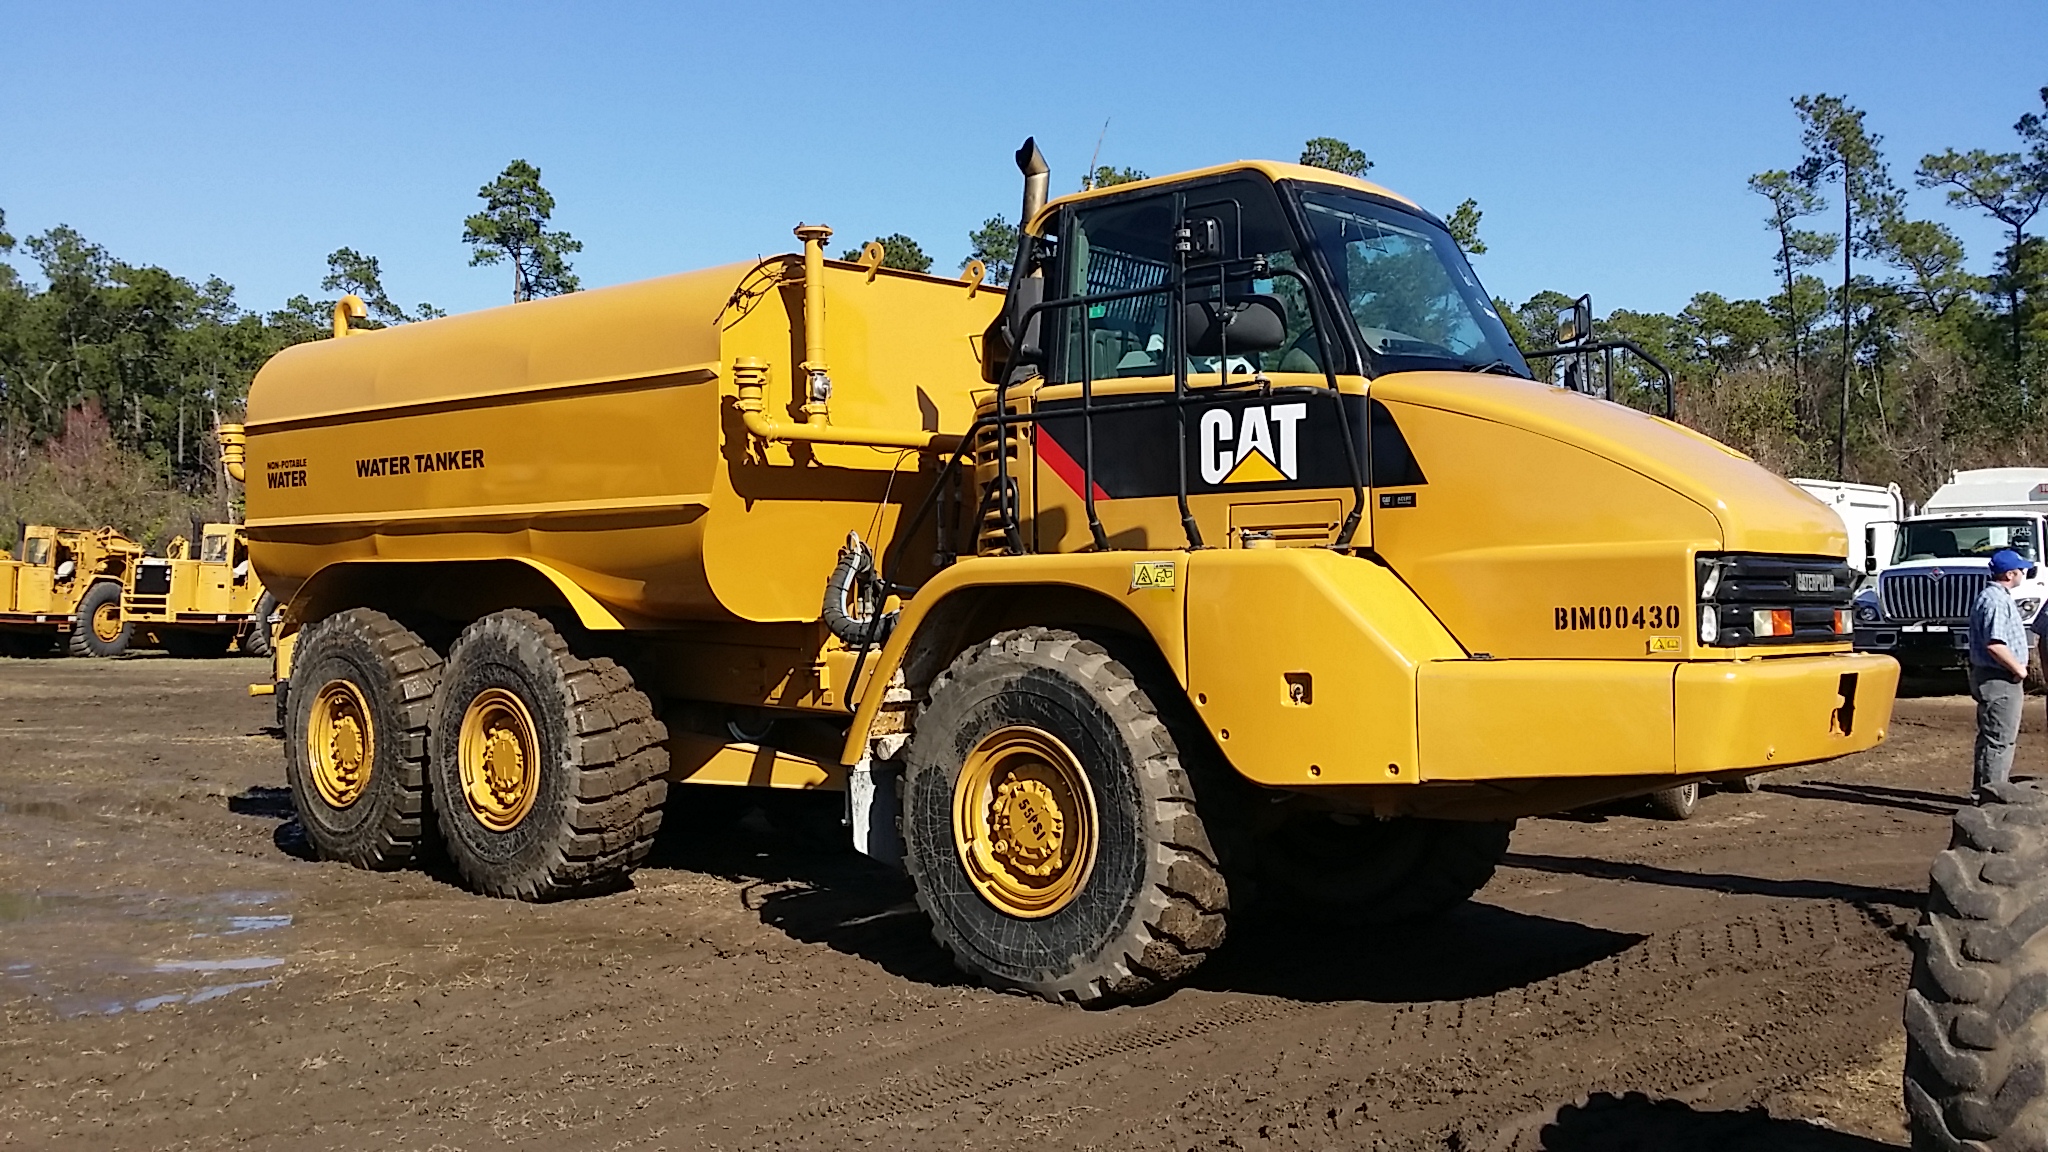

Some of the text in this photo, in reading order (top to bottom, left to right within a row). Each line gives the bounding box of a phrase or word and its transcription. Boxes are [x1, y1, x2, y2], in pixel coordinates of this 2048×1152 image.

[1200, 402, 1307, 484] CAT
[267, 458, 307, 470] NON-POTABLE
[356, 449, 485, 478] WATER TANKER
[267, 470, 307, 489] WATER
[1797, 573, 1835, 592] CATERPILLAR
[1554, 605, 1680, 631] BIM00430
[1018, 798, 1046, 841] 55PSI
